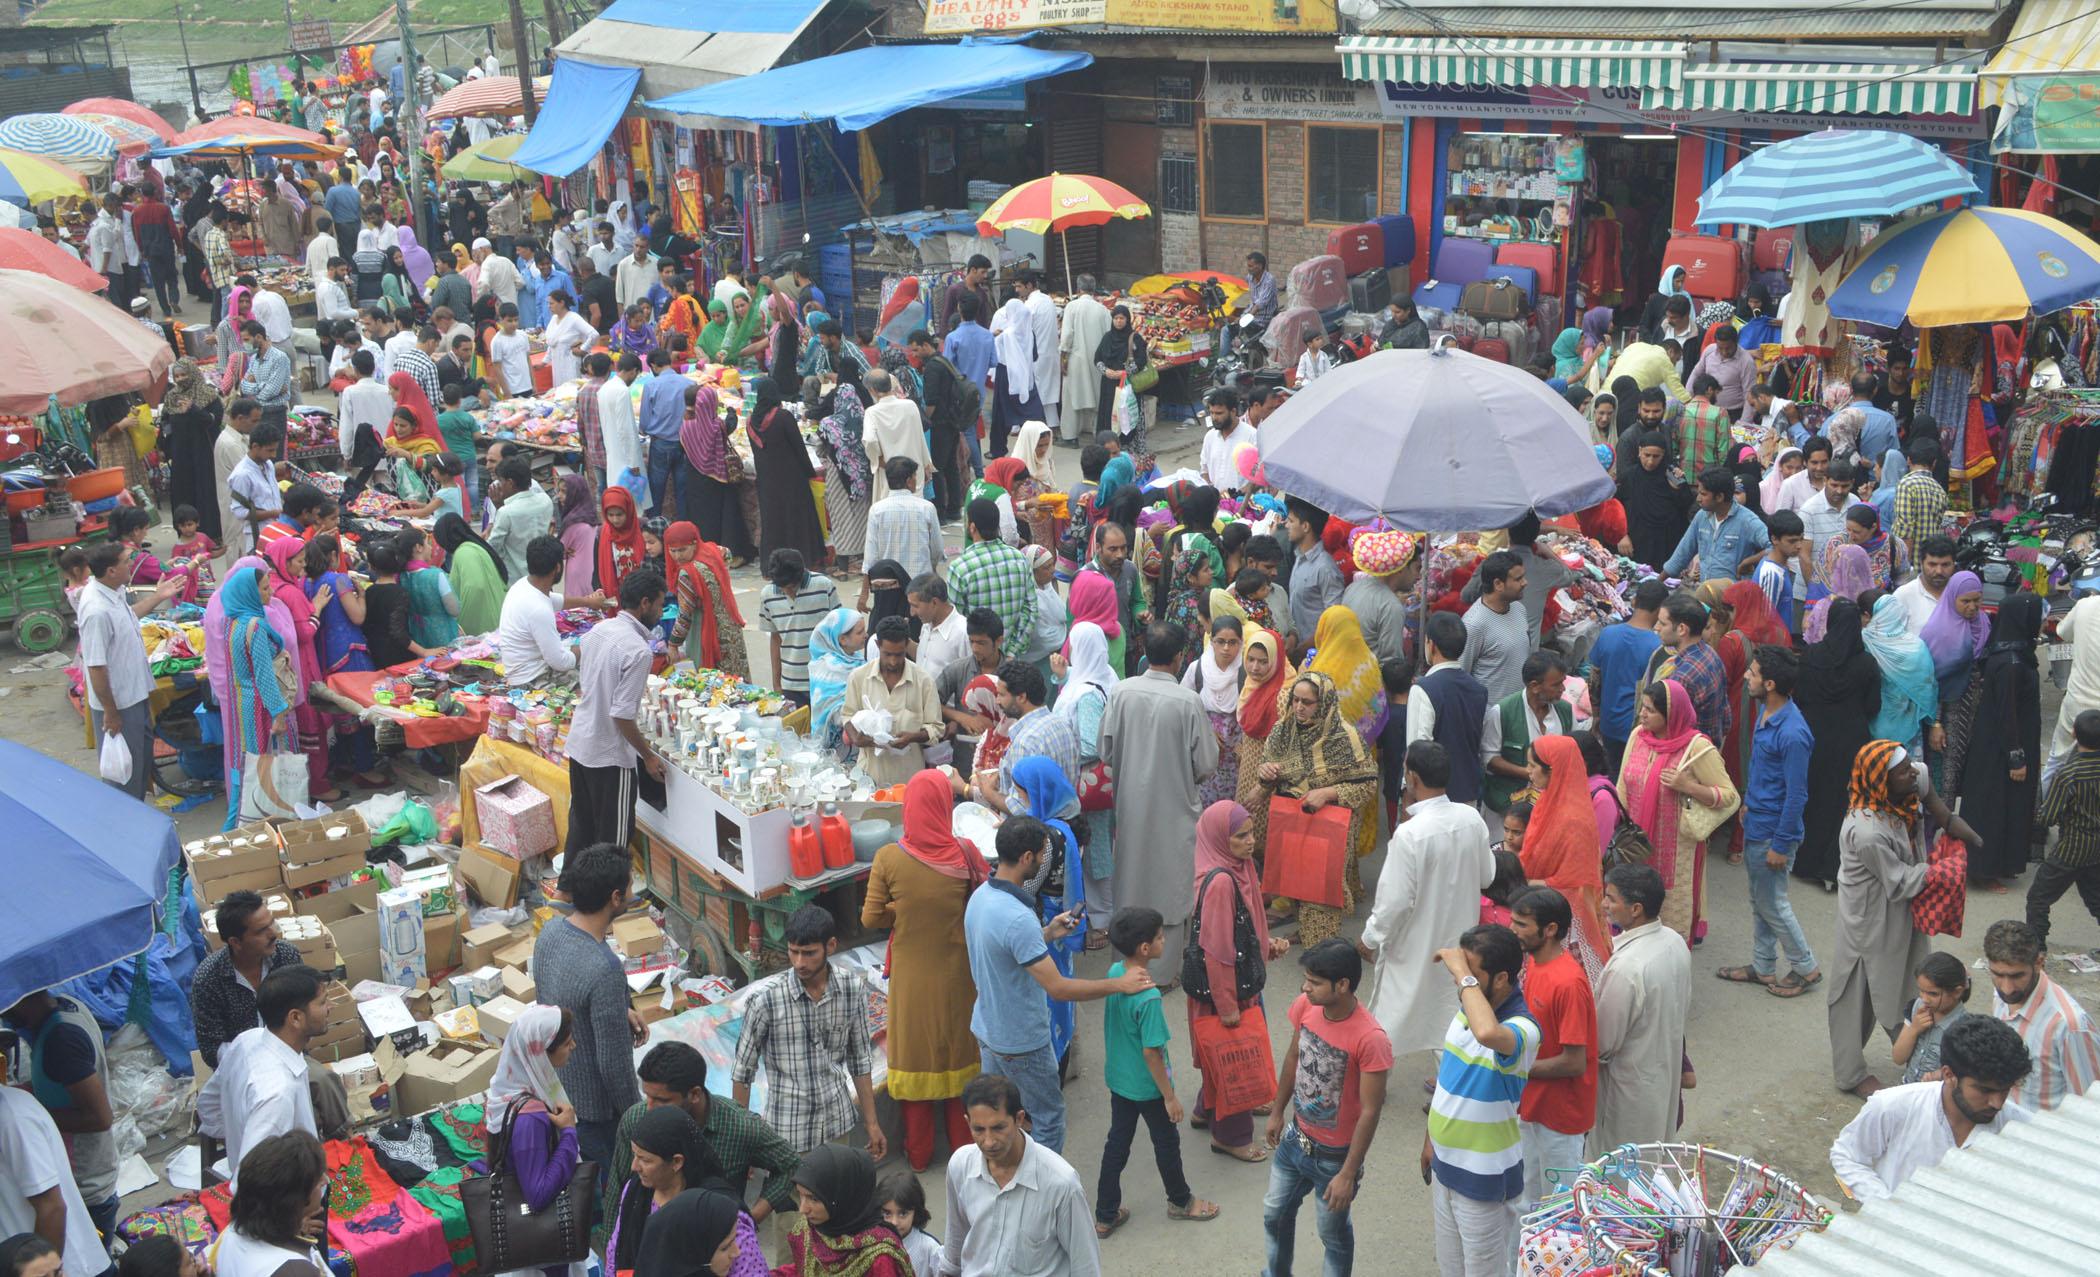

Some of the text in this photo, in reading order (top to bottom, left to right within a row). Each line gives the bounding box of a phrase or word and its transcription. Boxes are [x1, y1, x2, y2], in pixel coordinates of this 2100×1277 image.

[933, 0, 1029, 16] HEALTHY
[1039, 8, 1068, 20] POULTRY
[1071, 7, 1090, 17] SHOP
[1215, 3, 1249, 12] STAND
[1242, 87, 1356, 103] & OWNERS UNION
[1499, 106, 1535, 114] TOKYO
[1775, 117, 1808, 126] YORK
[1817, 119, 1857, 129] MILAN
[1868, 121, 1910, 130] TOKYO
[1920, 124, 1974, 134] SYDNEY
